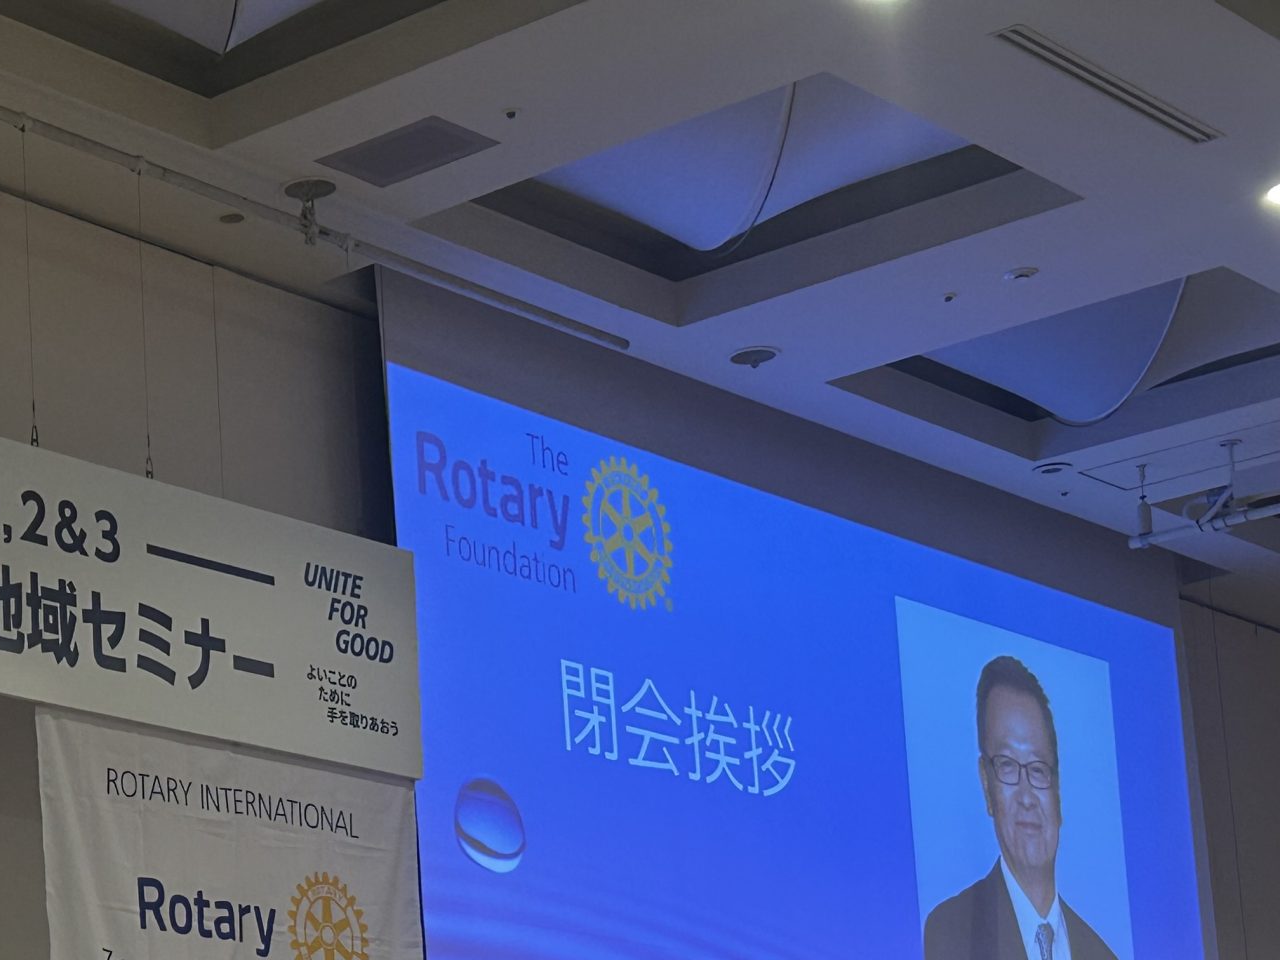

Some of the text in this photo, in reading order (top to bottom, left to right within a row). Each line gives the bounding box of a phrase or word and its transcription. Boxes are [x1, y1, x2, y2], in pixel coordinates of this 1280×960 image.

[526, 433, 568, 476] The
[416, 431, 570, 550] Rotary
[445, 524, 576, 593] Foundation
[304, 562, 363, 599] UNITE
[328, 597, 368, 629] FOR
[335, 629, 394, 663] GOOD
[306, 664, 357, 689] よいことの
[318, 686, 351, 707] ために
[326, 707, 399, 736] 手を取りあおう
[560, 659, 796, 797] 閉会挨拶
[106, 768, 359, 839] ROTARY INTERNATIONAL
[137, 877, 276, 957] Rotary
